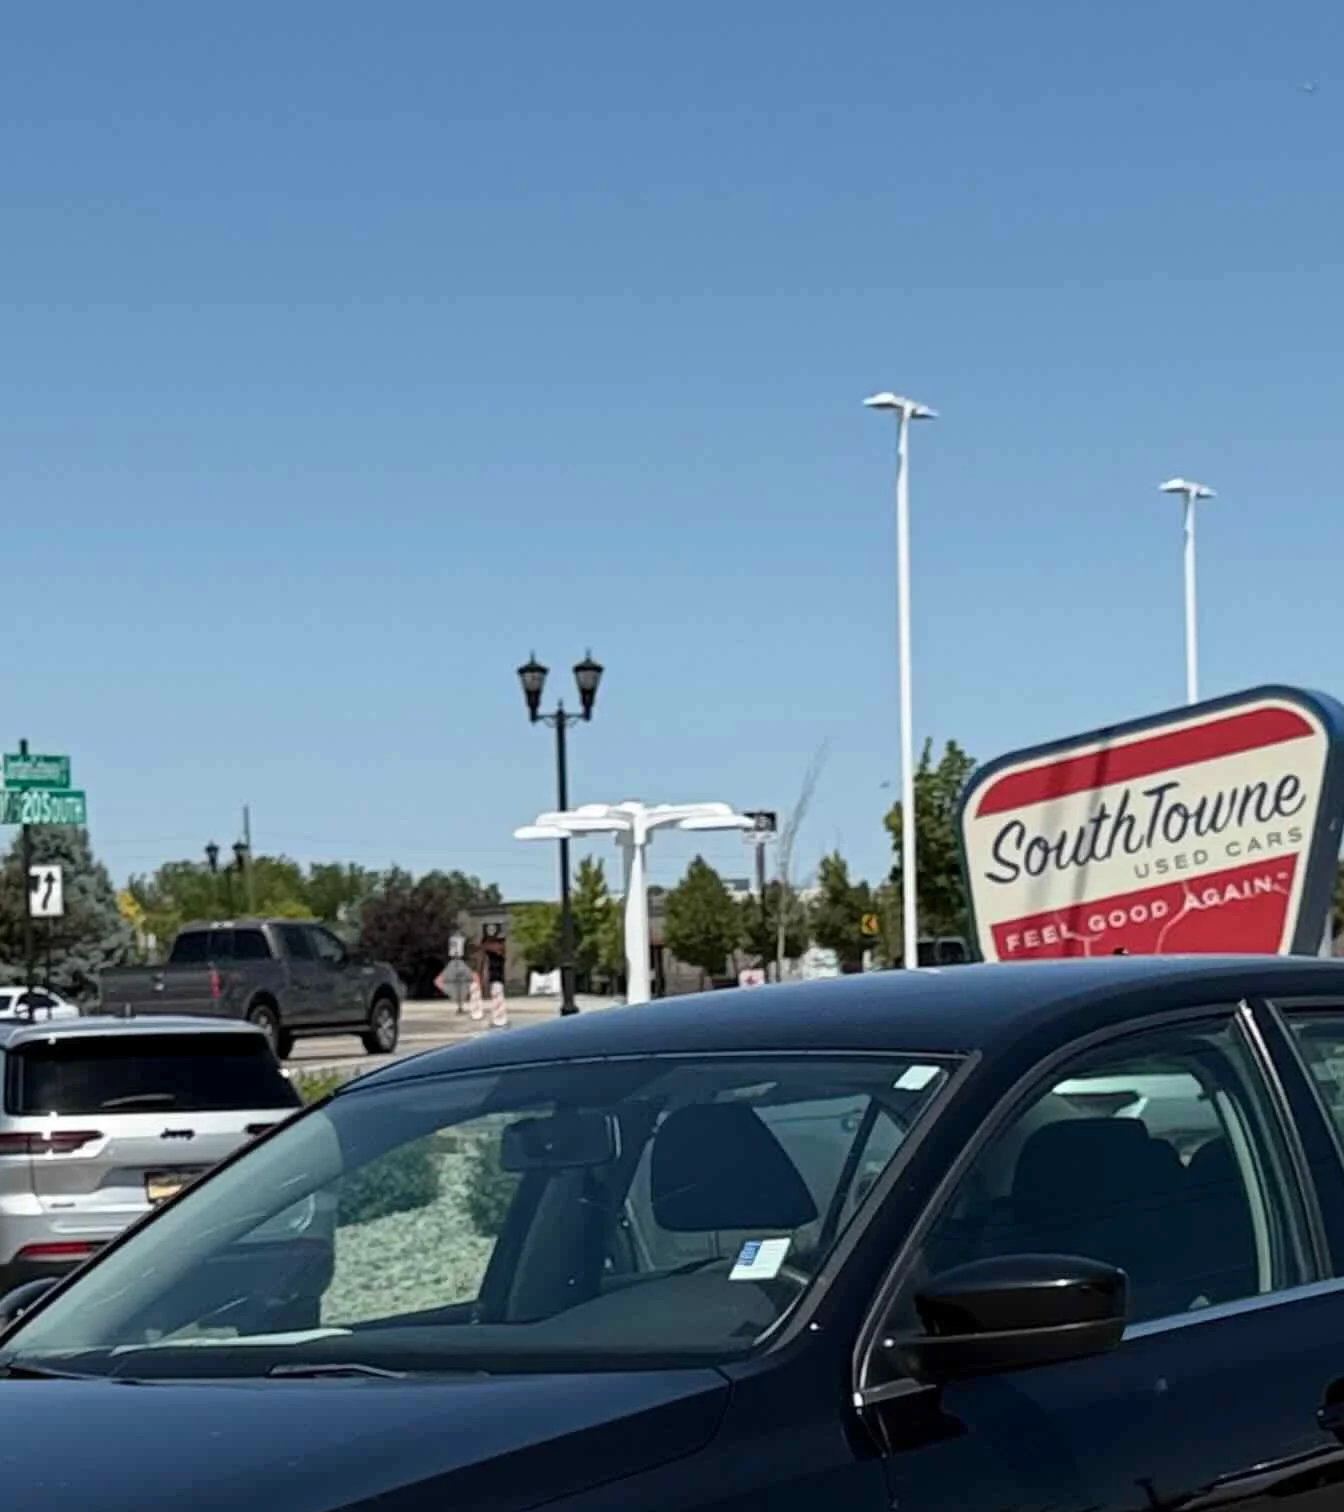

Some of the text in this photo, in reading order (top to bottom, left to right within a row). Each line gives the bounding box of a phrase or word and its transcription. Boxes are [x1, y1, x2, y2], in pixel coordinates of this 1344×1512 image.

[985, 774, 1306, 884] SouthTowne
[1134, 826, 1304, 880] USED CARS
[1005, 923, 1074, 953] FEEL
[1088, 901, 1168, 934] GOOD
